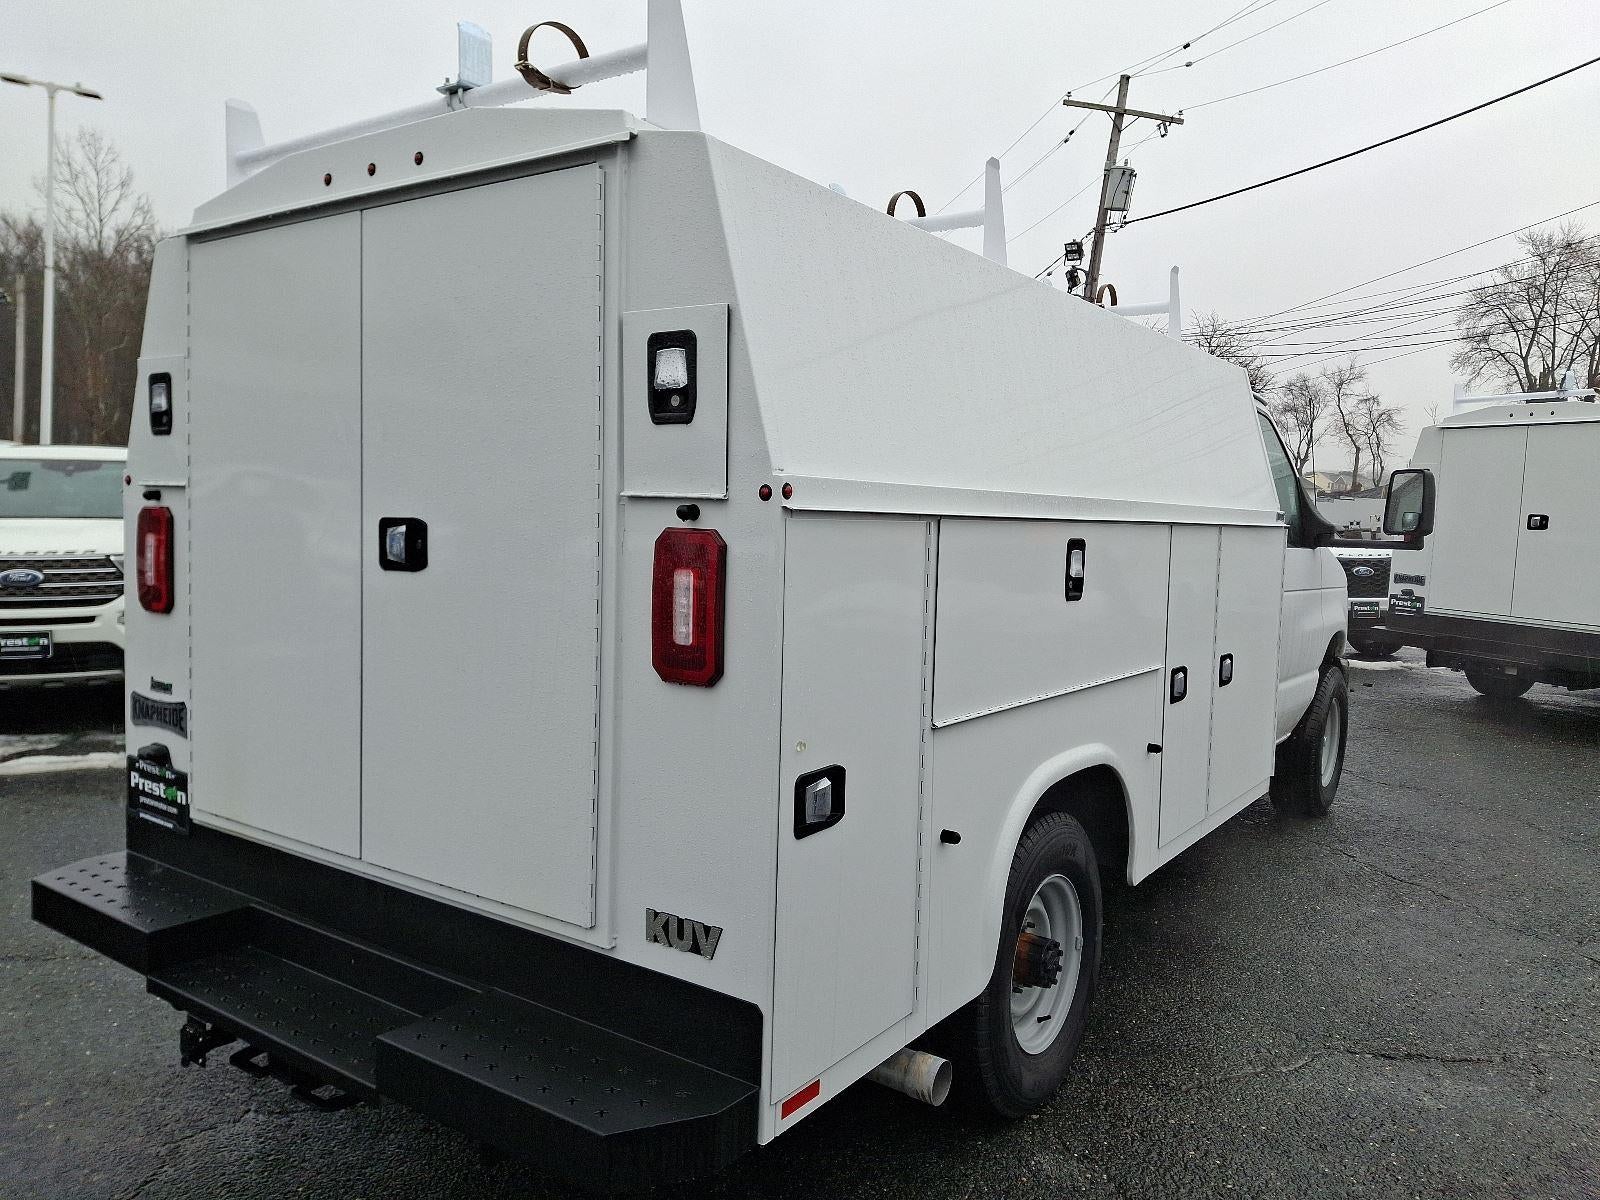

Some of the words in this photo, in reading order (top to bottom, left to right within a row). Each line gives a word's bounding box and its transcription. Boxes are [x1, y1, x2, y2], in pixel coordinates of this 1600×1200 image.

[0, 636, 48, 646] reston
[132, 693, 185, 734] KNAPHEIDE
[131, 770, 186, 806] Preston
[646, 908, 723, 960] KUV
